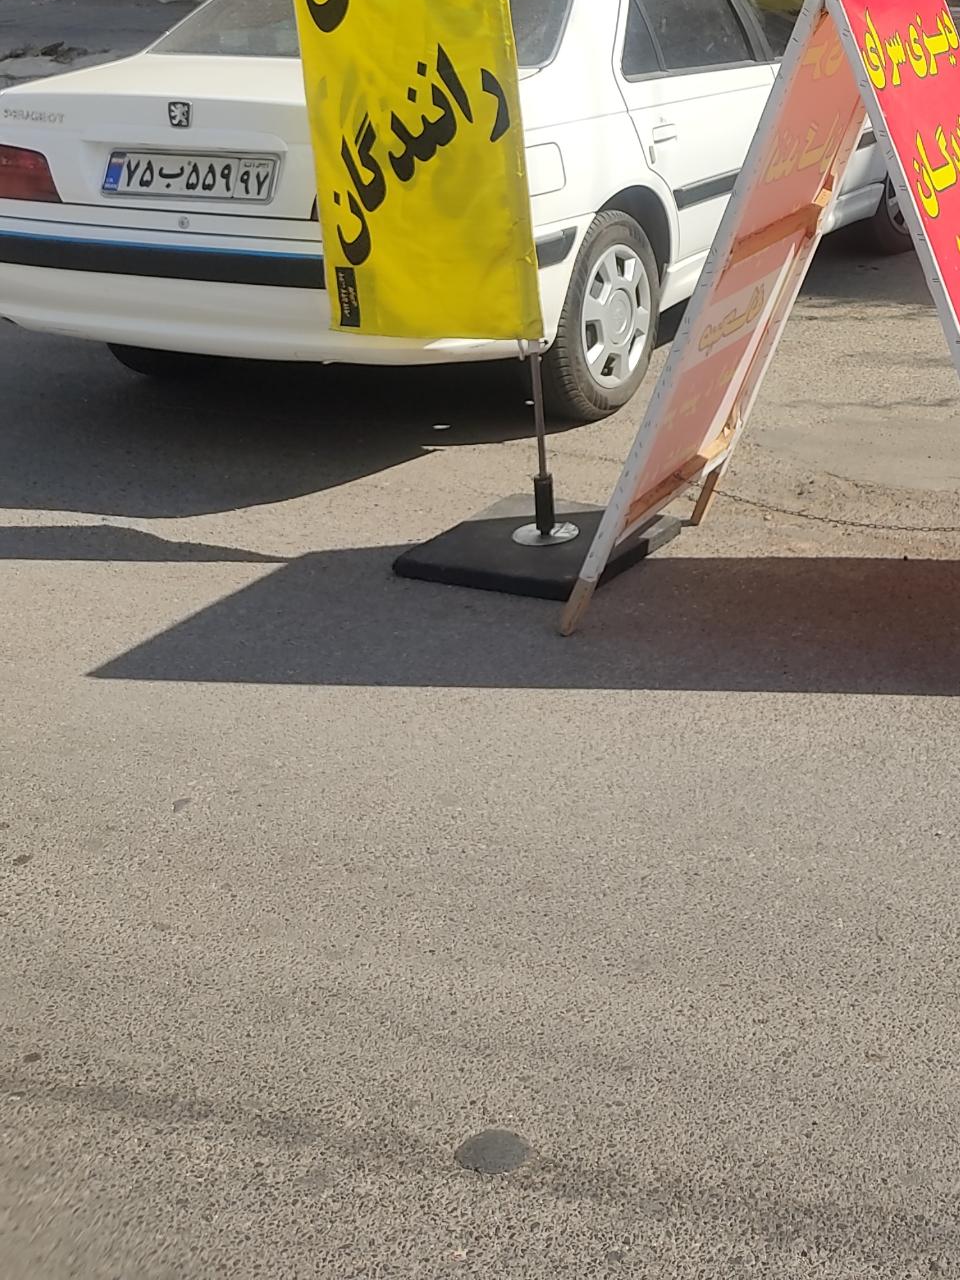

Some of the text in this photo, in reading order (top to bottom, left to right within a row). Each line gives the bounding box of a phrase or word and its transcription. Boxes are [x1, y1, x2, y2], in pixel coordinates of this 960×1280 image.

[861, 6, 908, 89] سرای
[906, 7, 960, 79] دیزی
[239, 169, 270, 197] ۹۷
[333, 42, 512, 267] رانندگان
